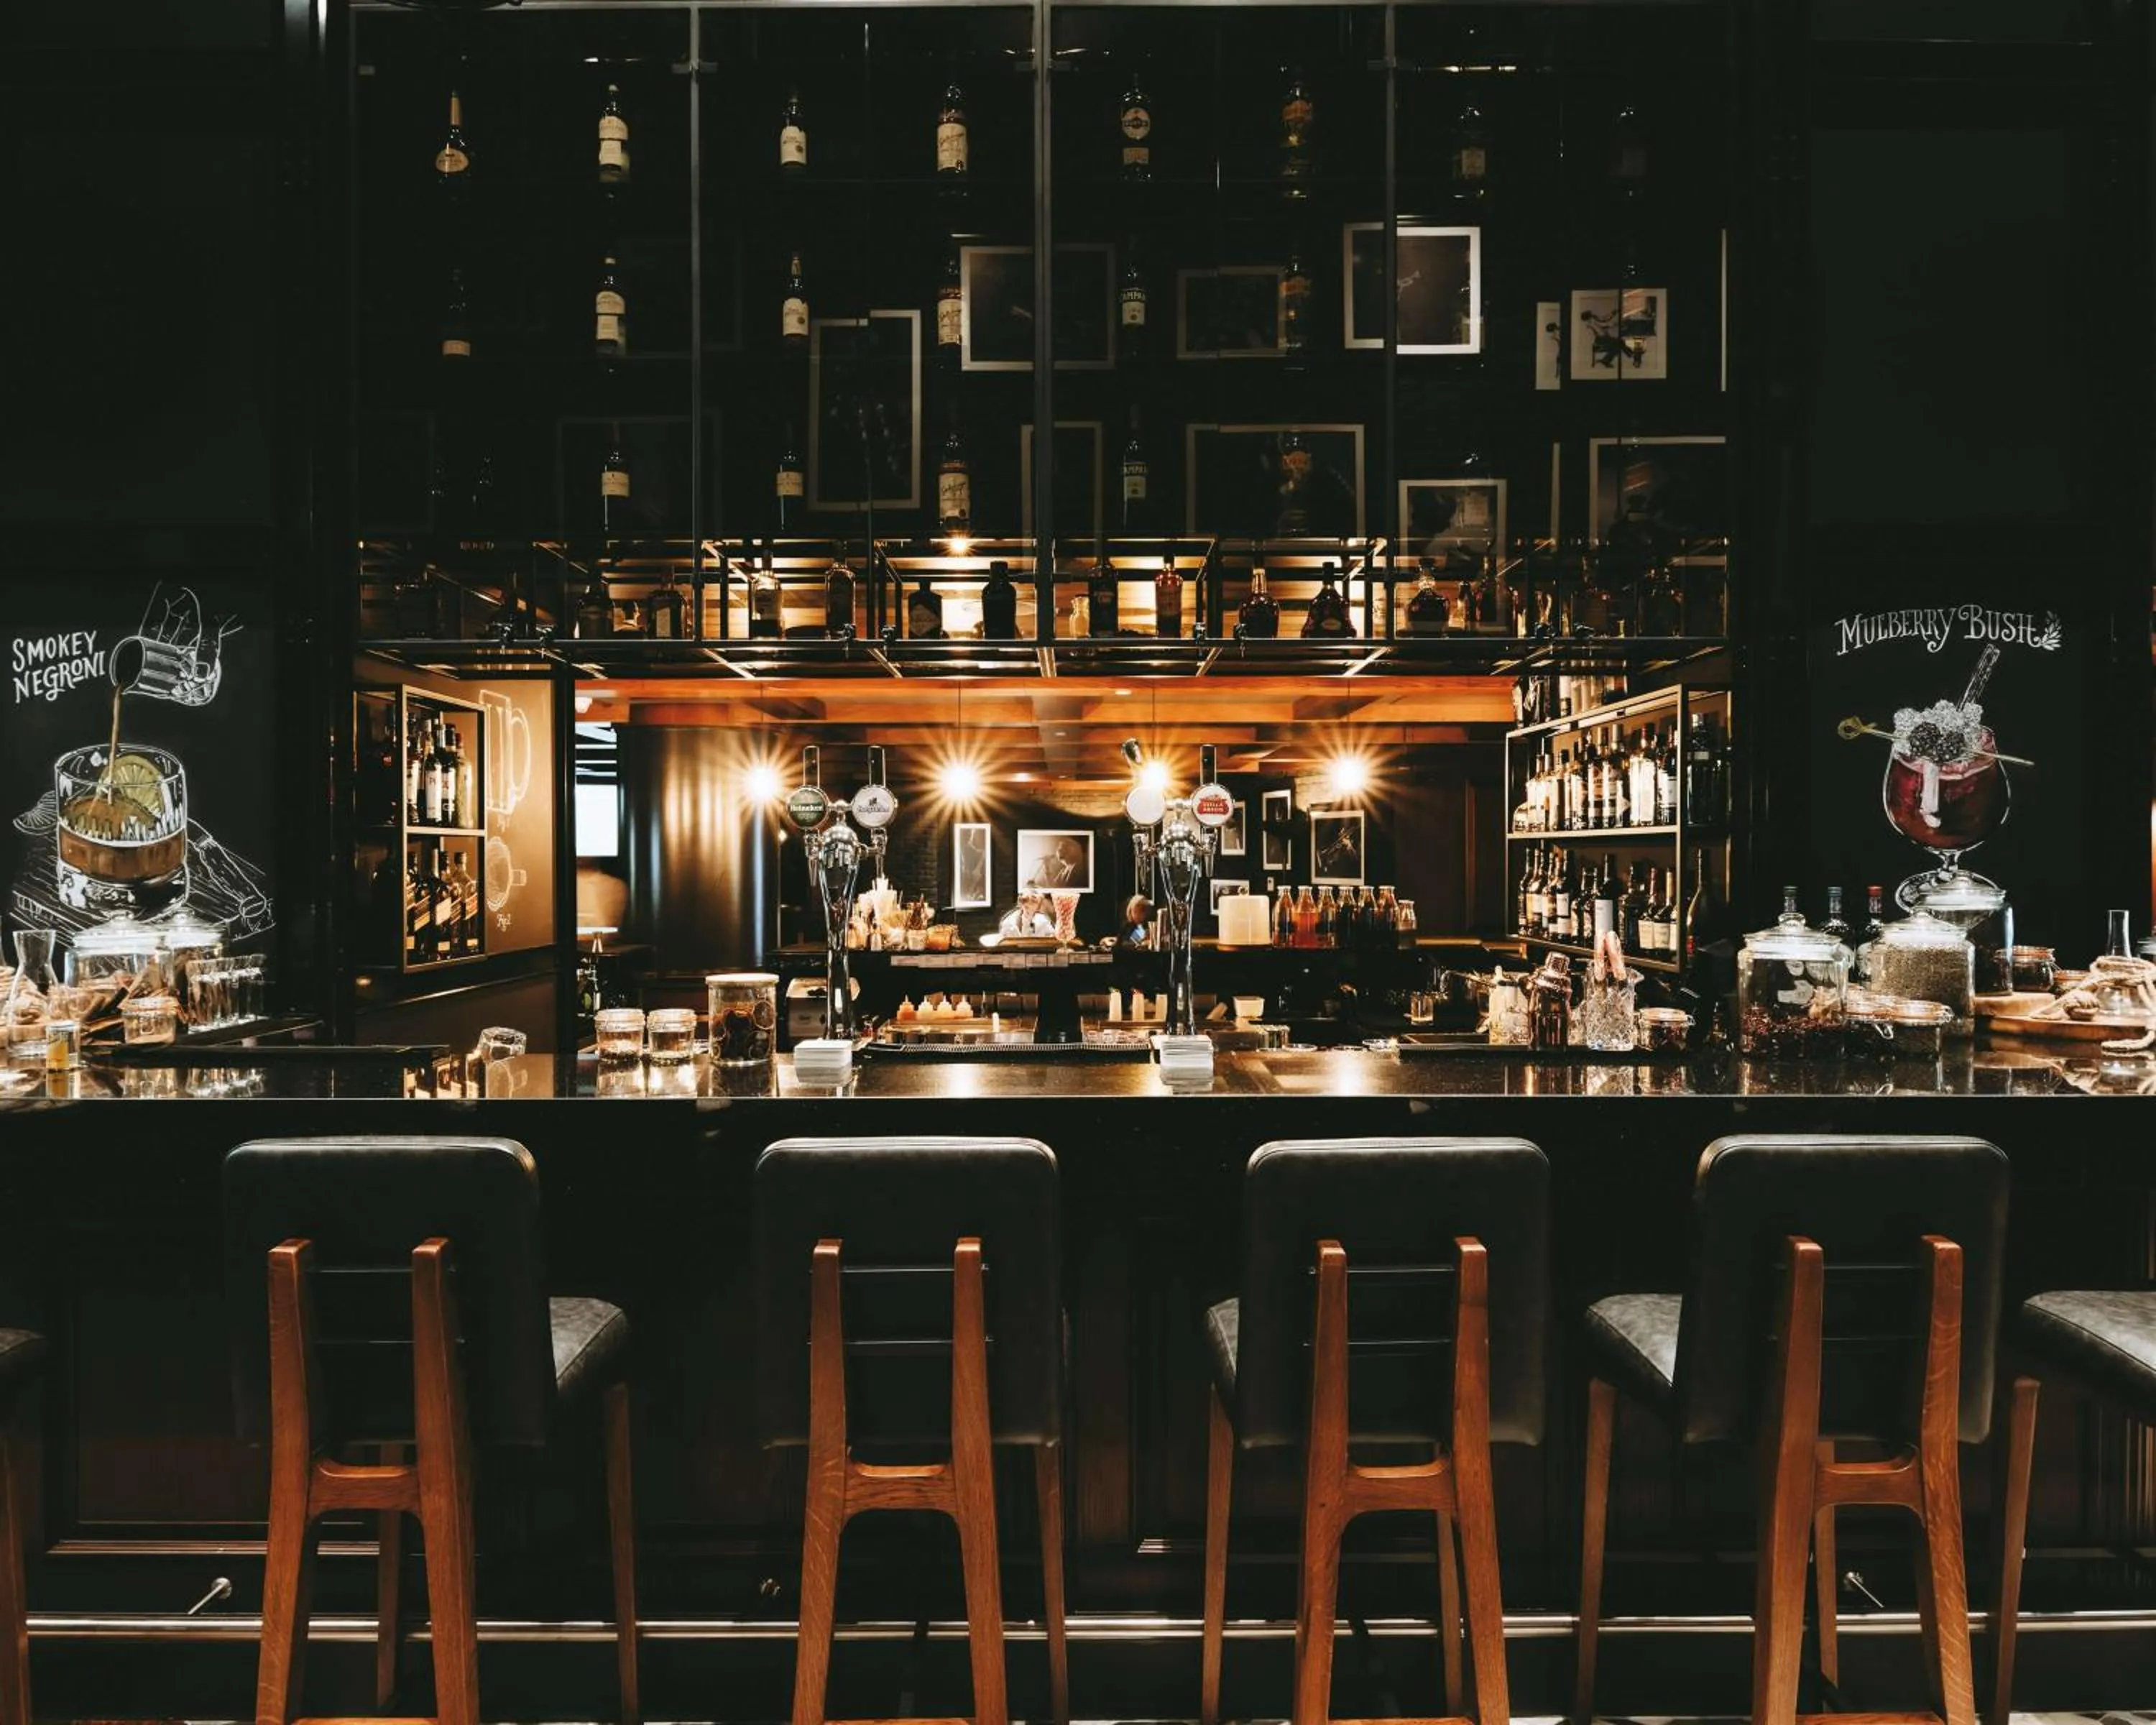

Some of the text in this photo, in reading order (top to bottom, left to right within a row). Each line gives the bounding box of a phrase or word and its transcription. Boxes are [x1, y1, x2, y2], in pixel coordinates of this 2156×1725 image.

[12, 630, 97, 672] SMOKEY
[1833, 604, 2042, 656] MULBERRY BUSH
[12, 650, 106, 704] NEGRONI
